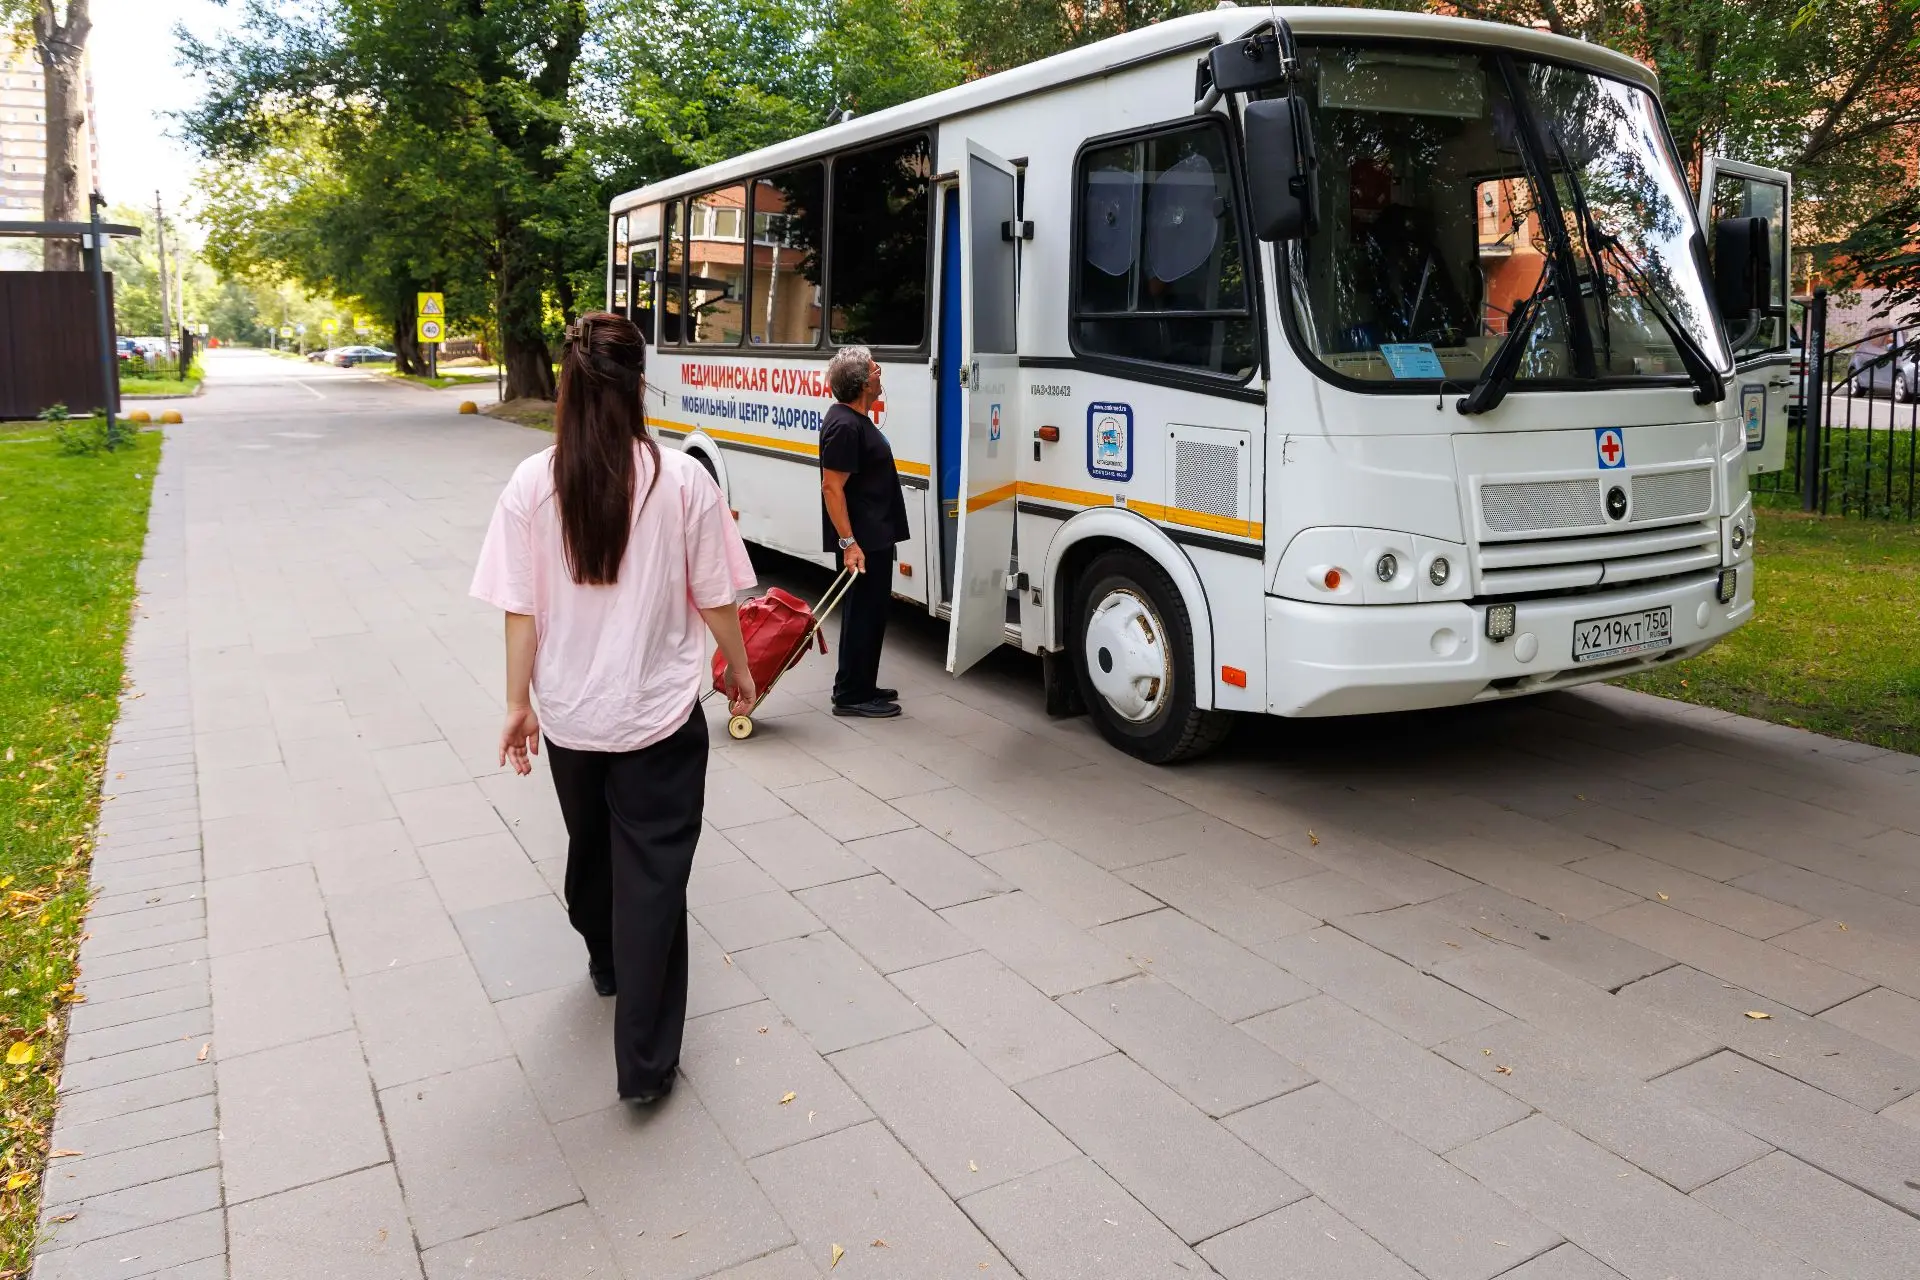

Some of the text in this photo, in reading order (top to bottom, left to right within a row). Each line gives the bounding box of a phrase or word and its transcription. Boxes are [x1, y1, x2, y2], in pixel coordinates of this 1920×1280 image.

[425, 326, 437, 334] 40
[682, 363, 832, 398] МЕДИЦИНСКАЯ СЛУЖБА
[681, 395, 823, 432] МОБИЛЬНЫЙ ЦЕНТР ЗДОРОВЬ
[1645, 611, 1668, 632] 750
[1649, 631, 1661, 639] RUS
